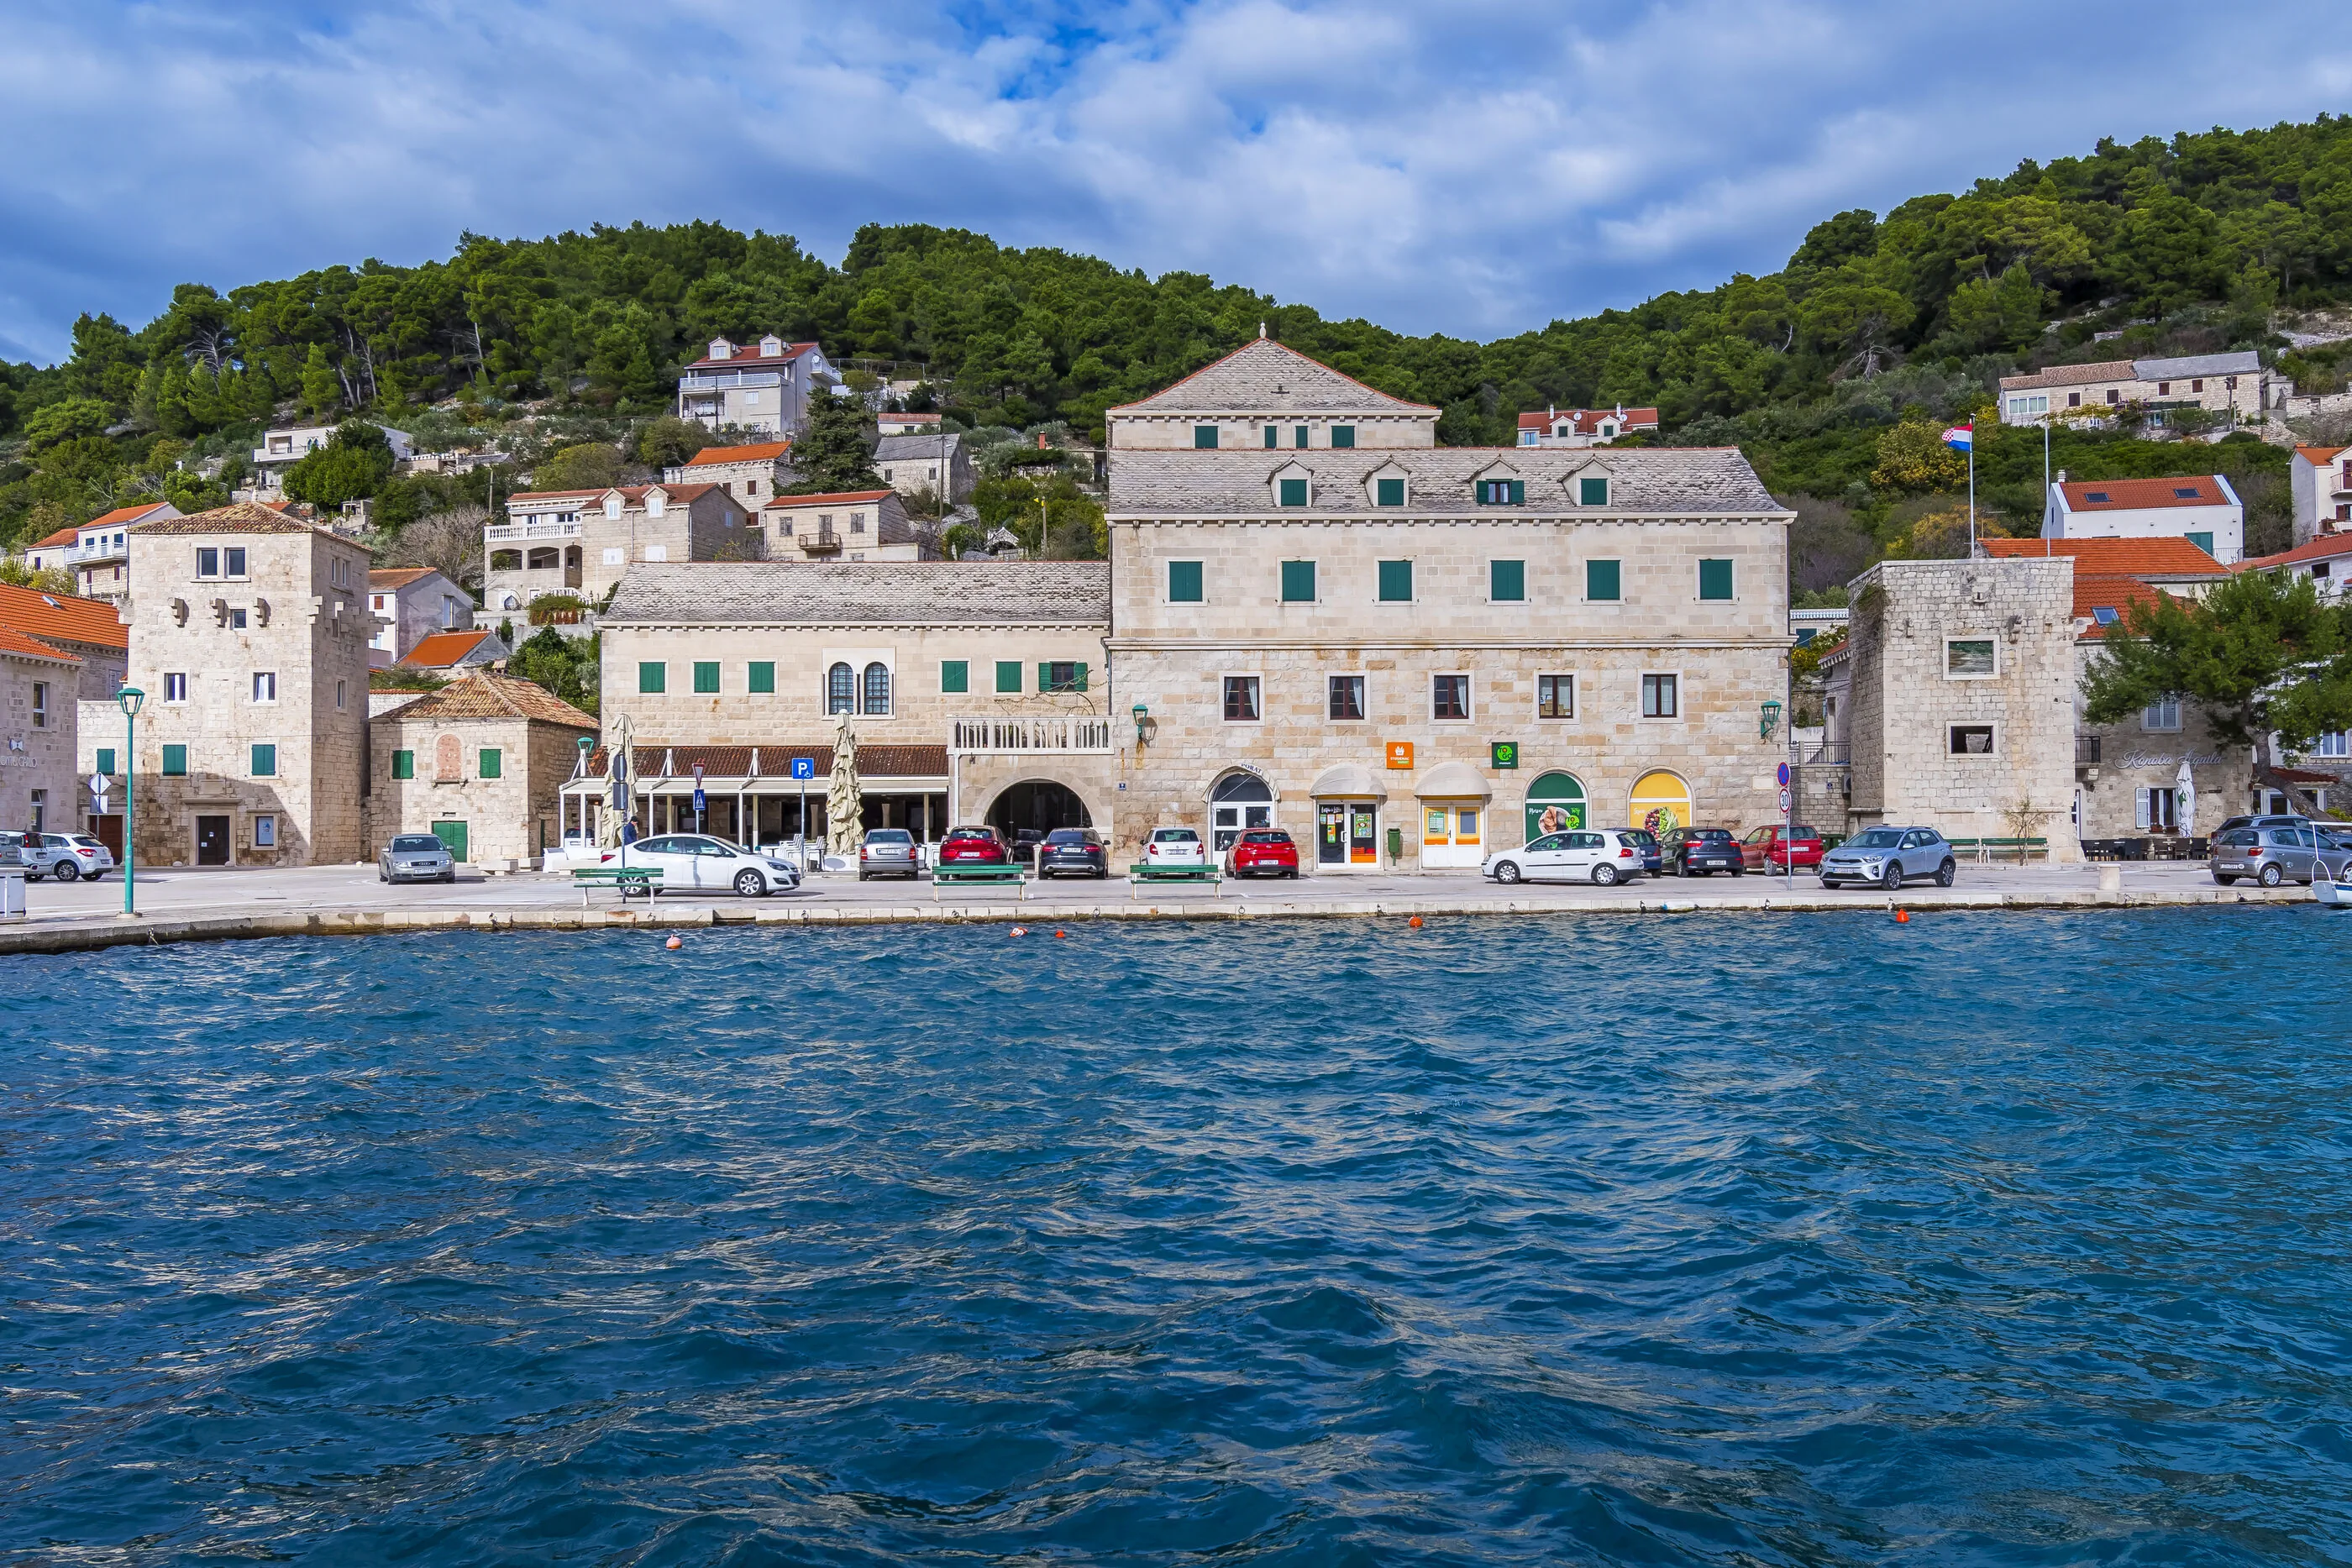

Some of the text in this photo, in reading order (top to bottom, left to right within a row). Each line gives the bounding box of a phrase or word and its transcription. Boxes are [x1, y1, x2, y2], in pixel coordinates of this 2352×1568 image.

[2115, 747, 2223, 768] Konoba Aquila
[798, 762, 807, 775] P
[1241, 763, 1262, 774] PORAT
[1781, 794, 1788, 807] 30
